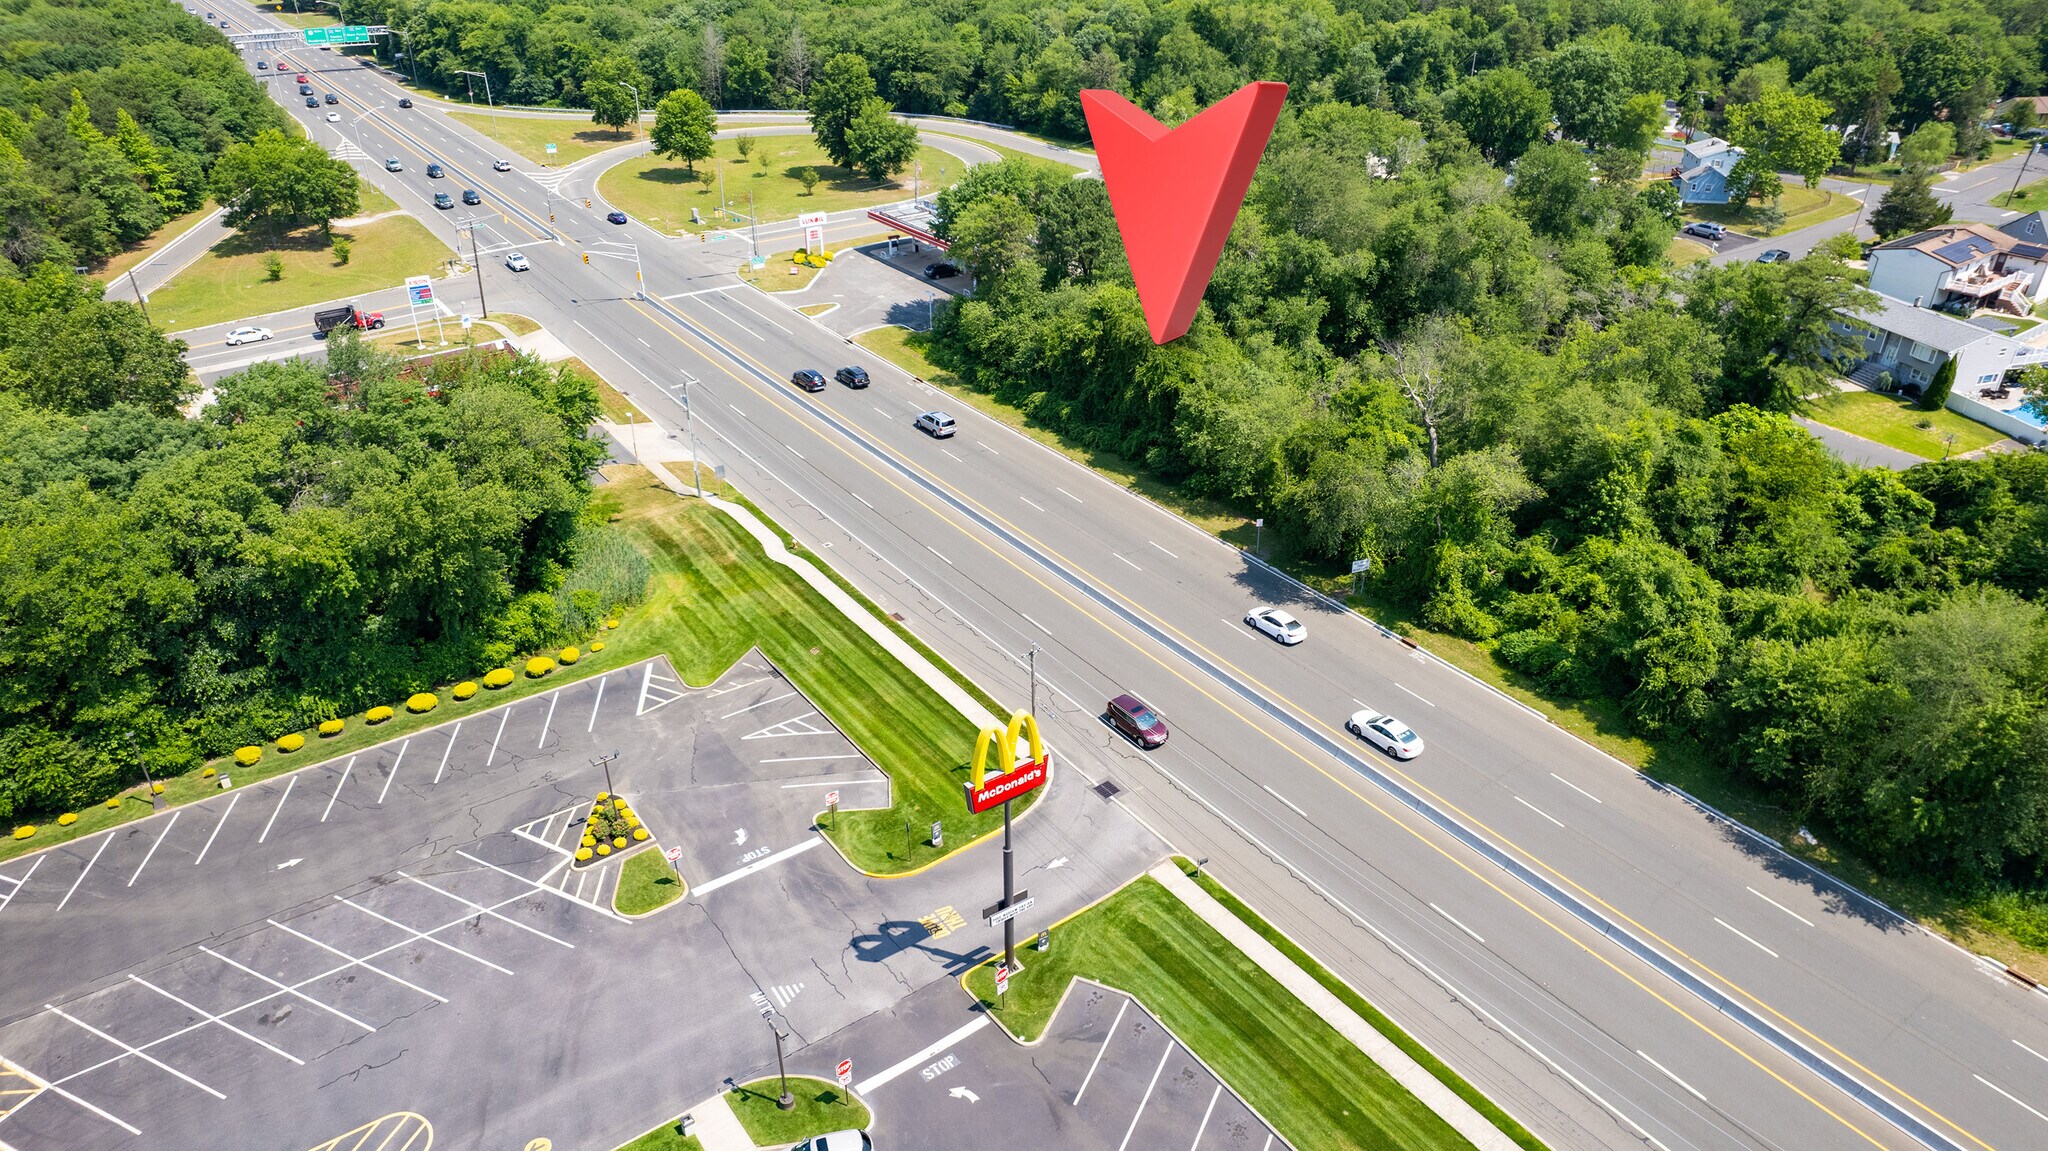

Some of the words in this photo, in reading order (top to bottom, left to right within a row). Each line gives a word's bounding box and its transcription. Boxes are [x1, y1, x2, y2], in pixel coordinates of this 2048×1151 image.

[978, 768, 1042, 803] McDonald's
[742, 845, 771, 863] STOP
[836, 1061, 852, 1075] STOP
[922, 1055, 955, 1080] STOP
